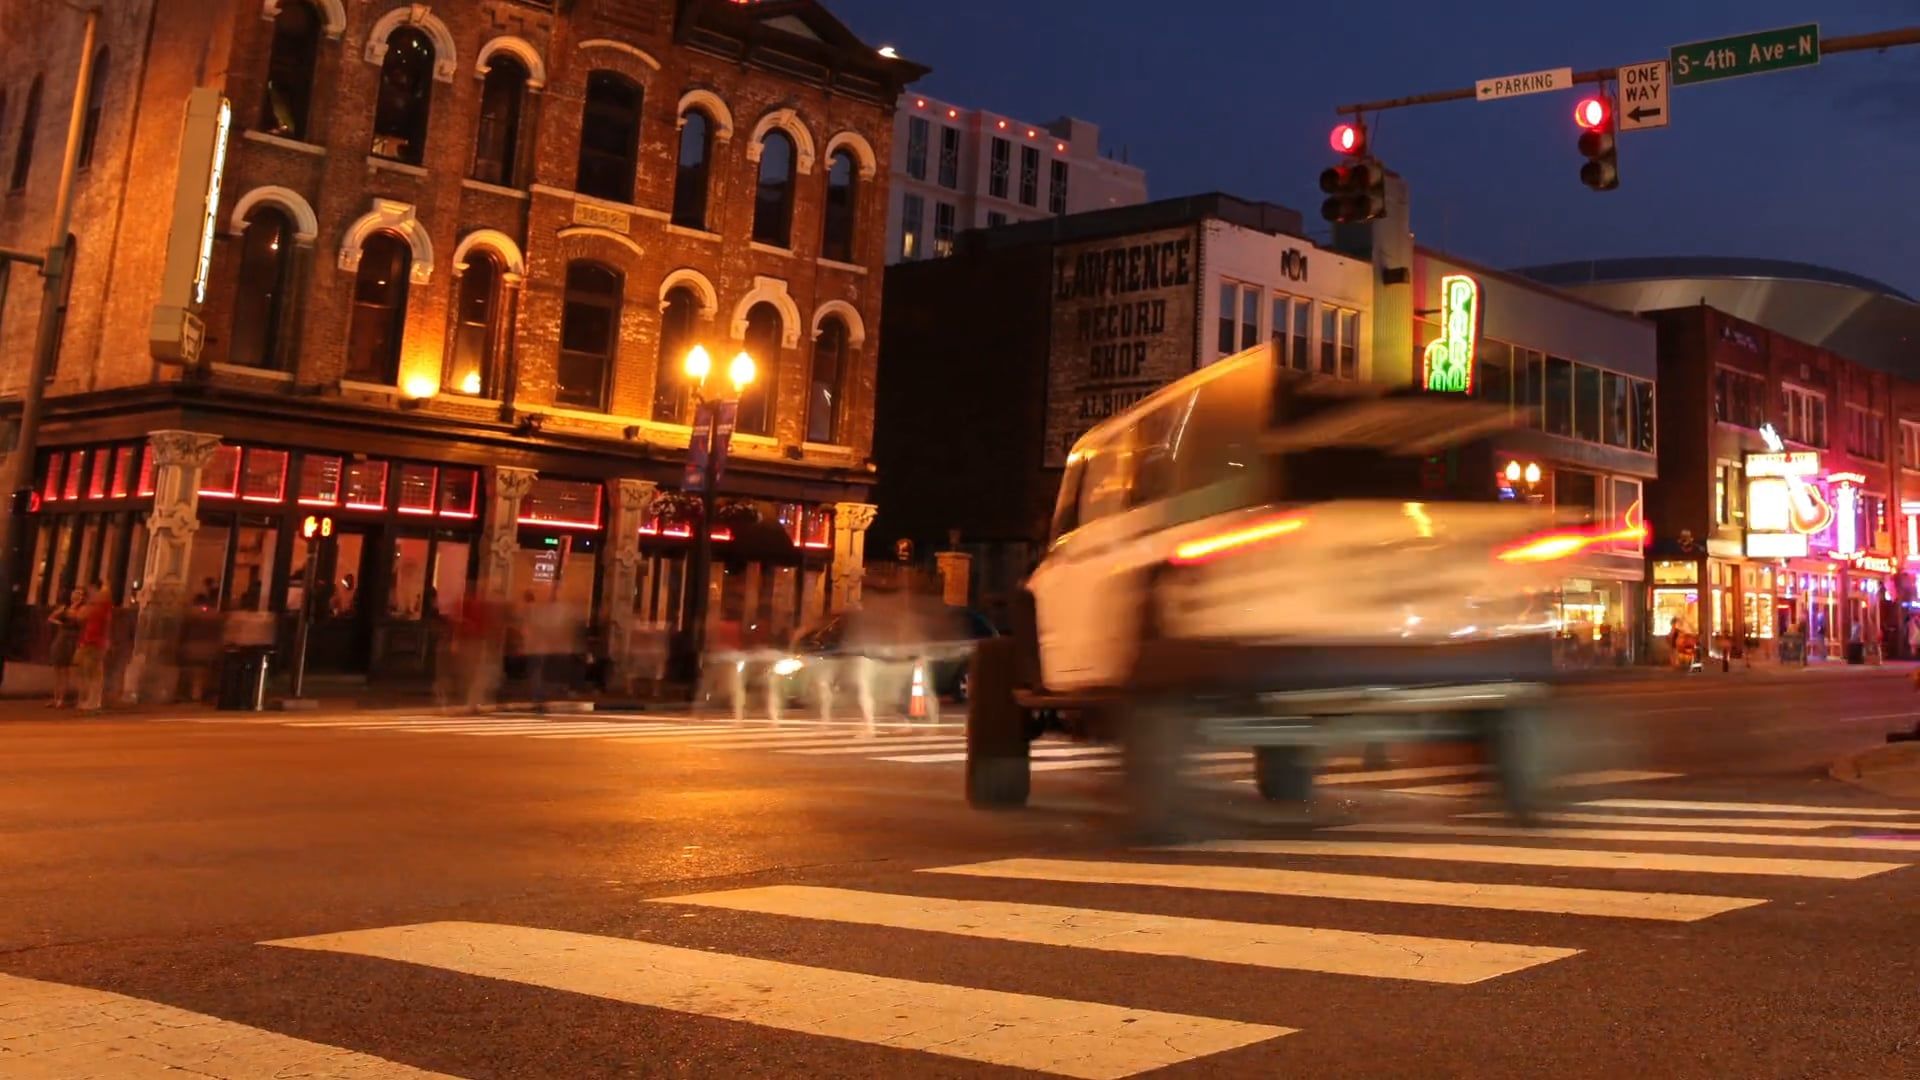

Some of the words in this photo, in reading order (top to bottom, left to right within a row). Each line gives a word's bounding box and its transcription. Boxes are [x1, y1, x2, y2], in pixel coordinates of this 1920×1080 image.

[1494, 73, 1553, 95] PARKING
[1625, 66, 1659, 85] ONE
[1625, 83, 1661, 102] WAY
[1055, 239, 1191, 300] LAWRENCE
[1077, 299, 1166, 343] RECORD
[1090, 341, 1146, 379] SHOP
